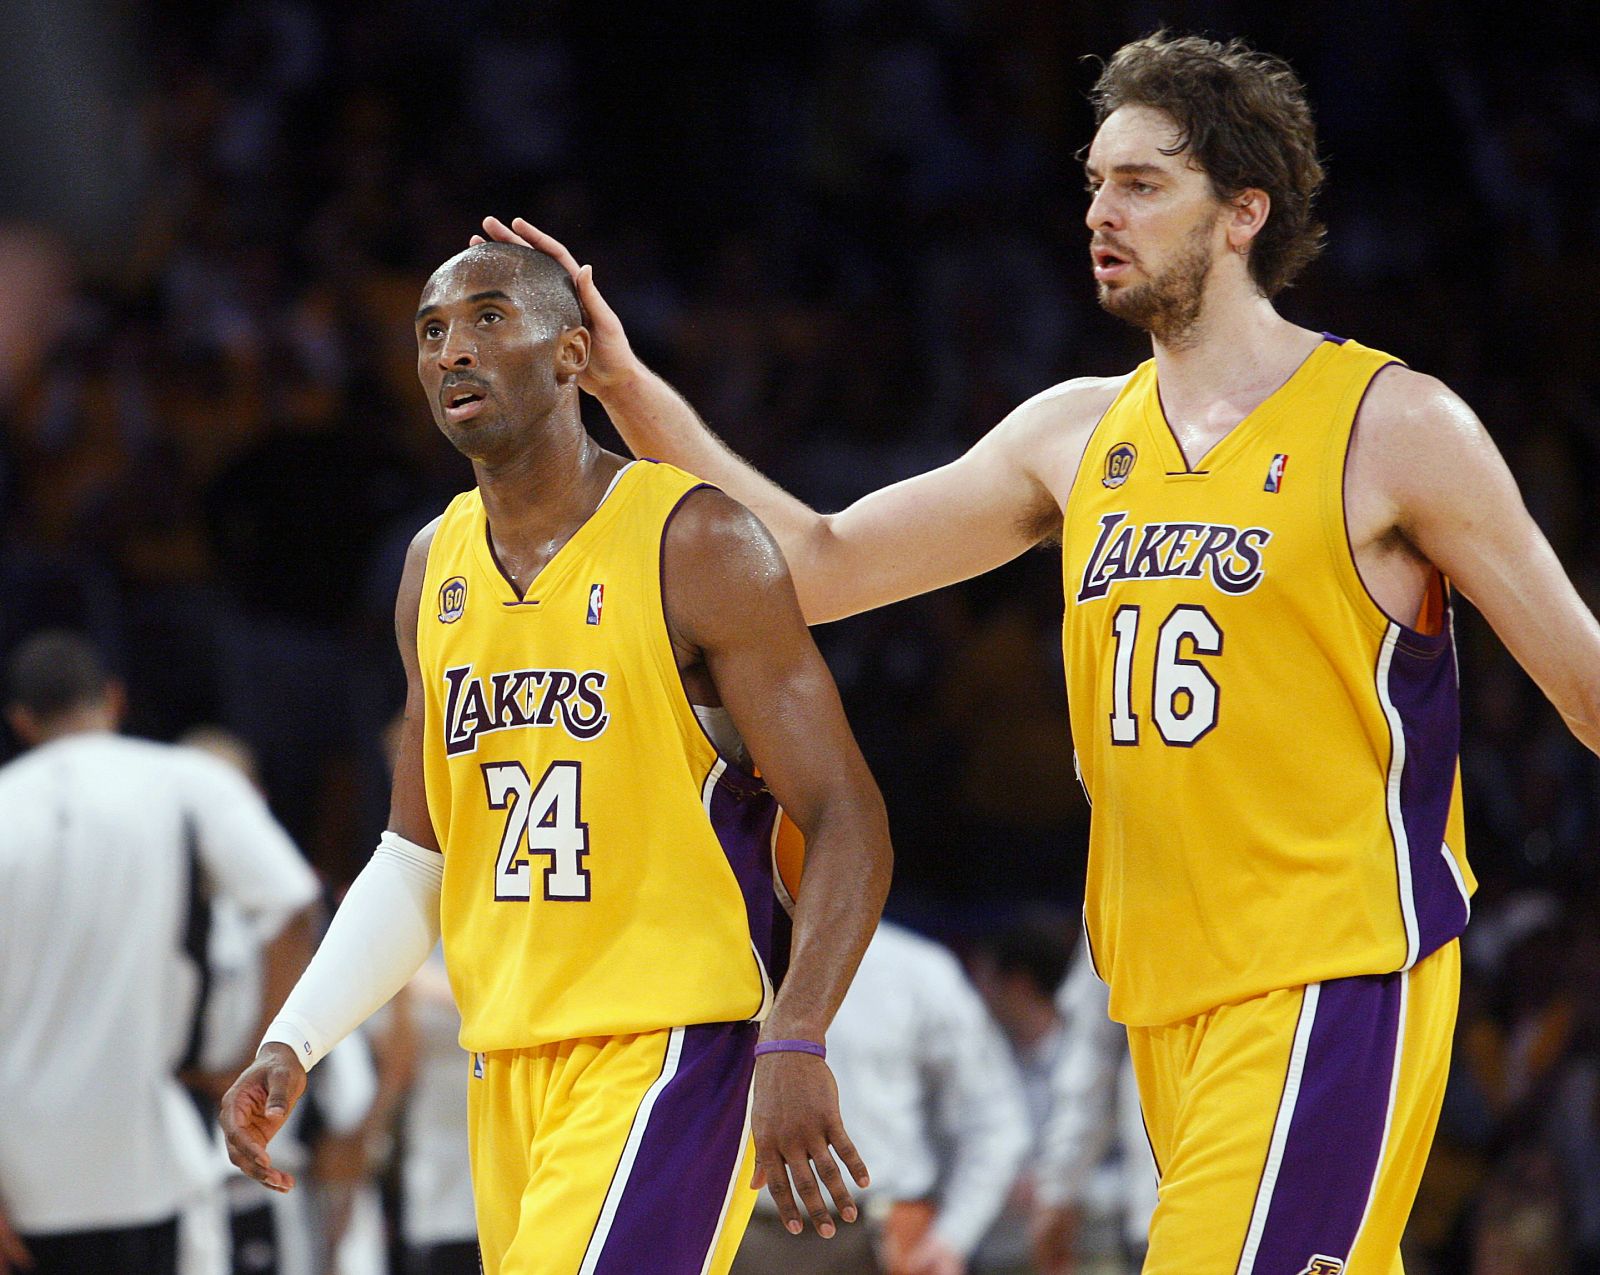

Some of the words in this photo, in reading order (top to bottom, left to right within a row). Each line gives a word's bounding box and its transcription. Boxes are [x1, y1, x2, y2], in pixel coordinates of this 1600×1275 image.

[1111, 455, 1130, 476] 60
[445, 588, 463, 612] 60
[1076, 511, 1272, 605] LAKERS
[443, 663, 610, 758] LAKERS
[1109, 603, 1224, 748] 16
[480, 760, 591, 902] 24
